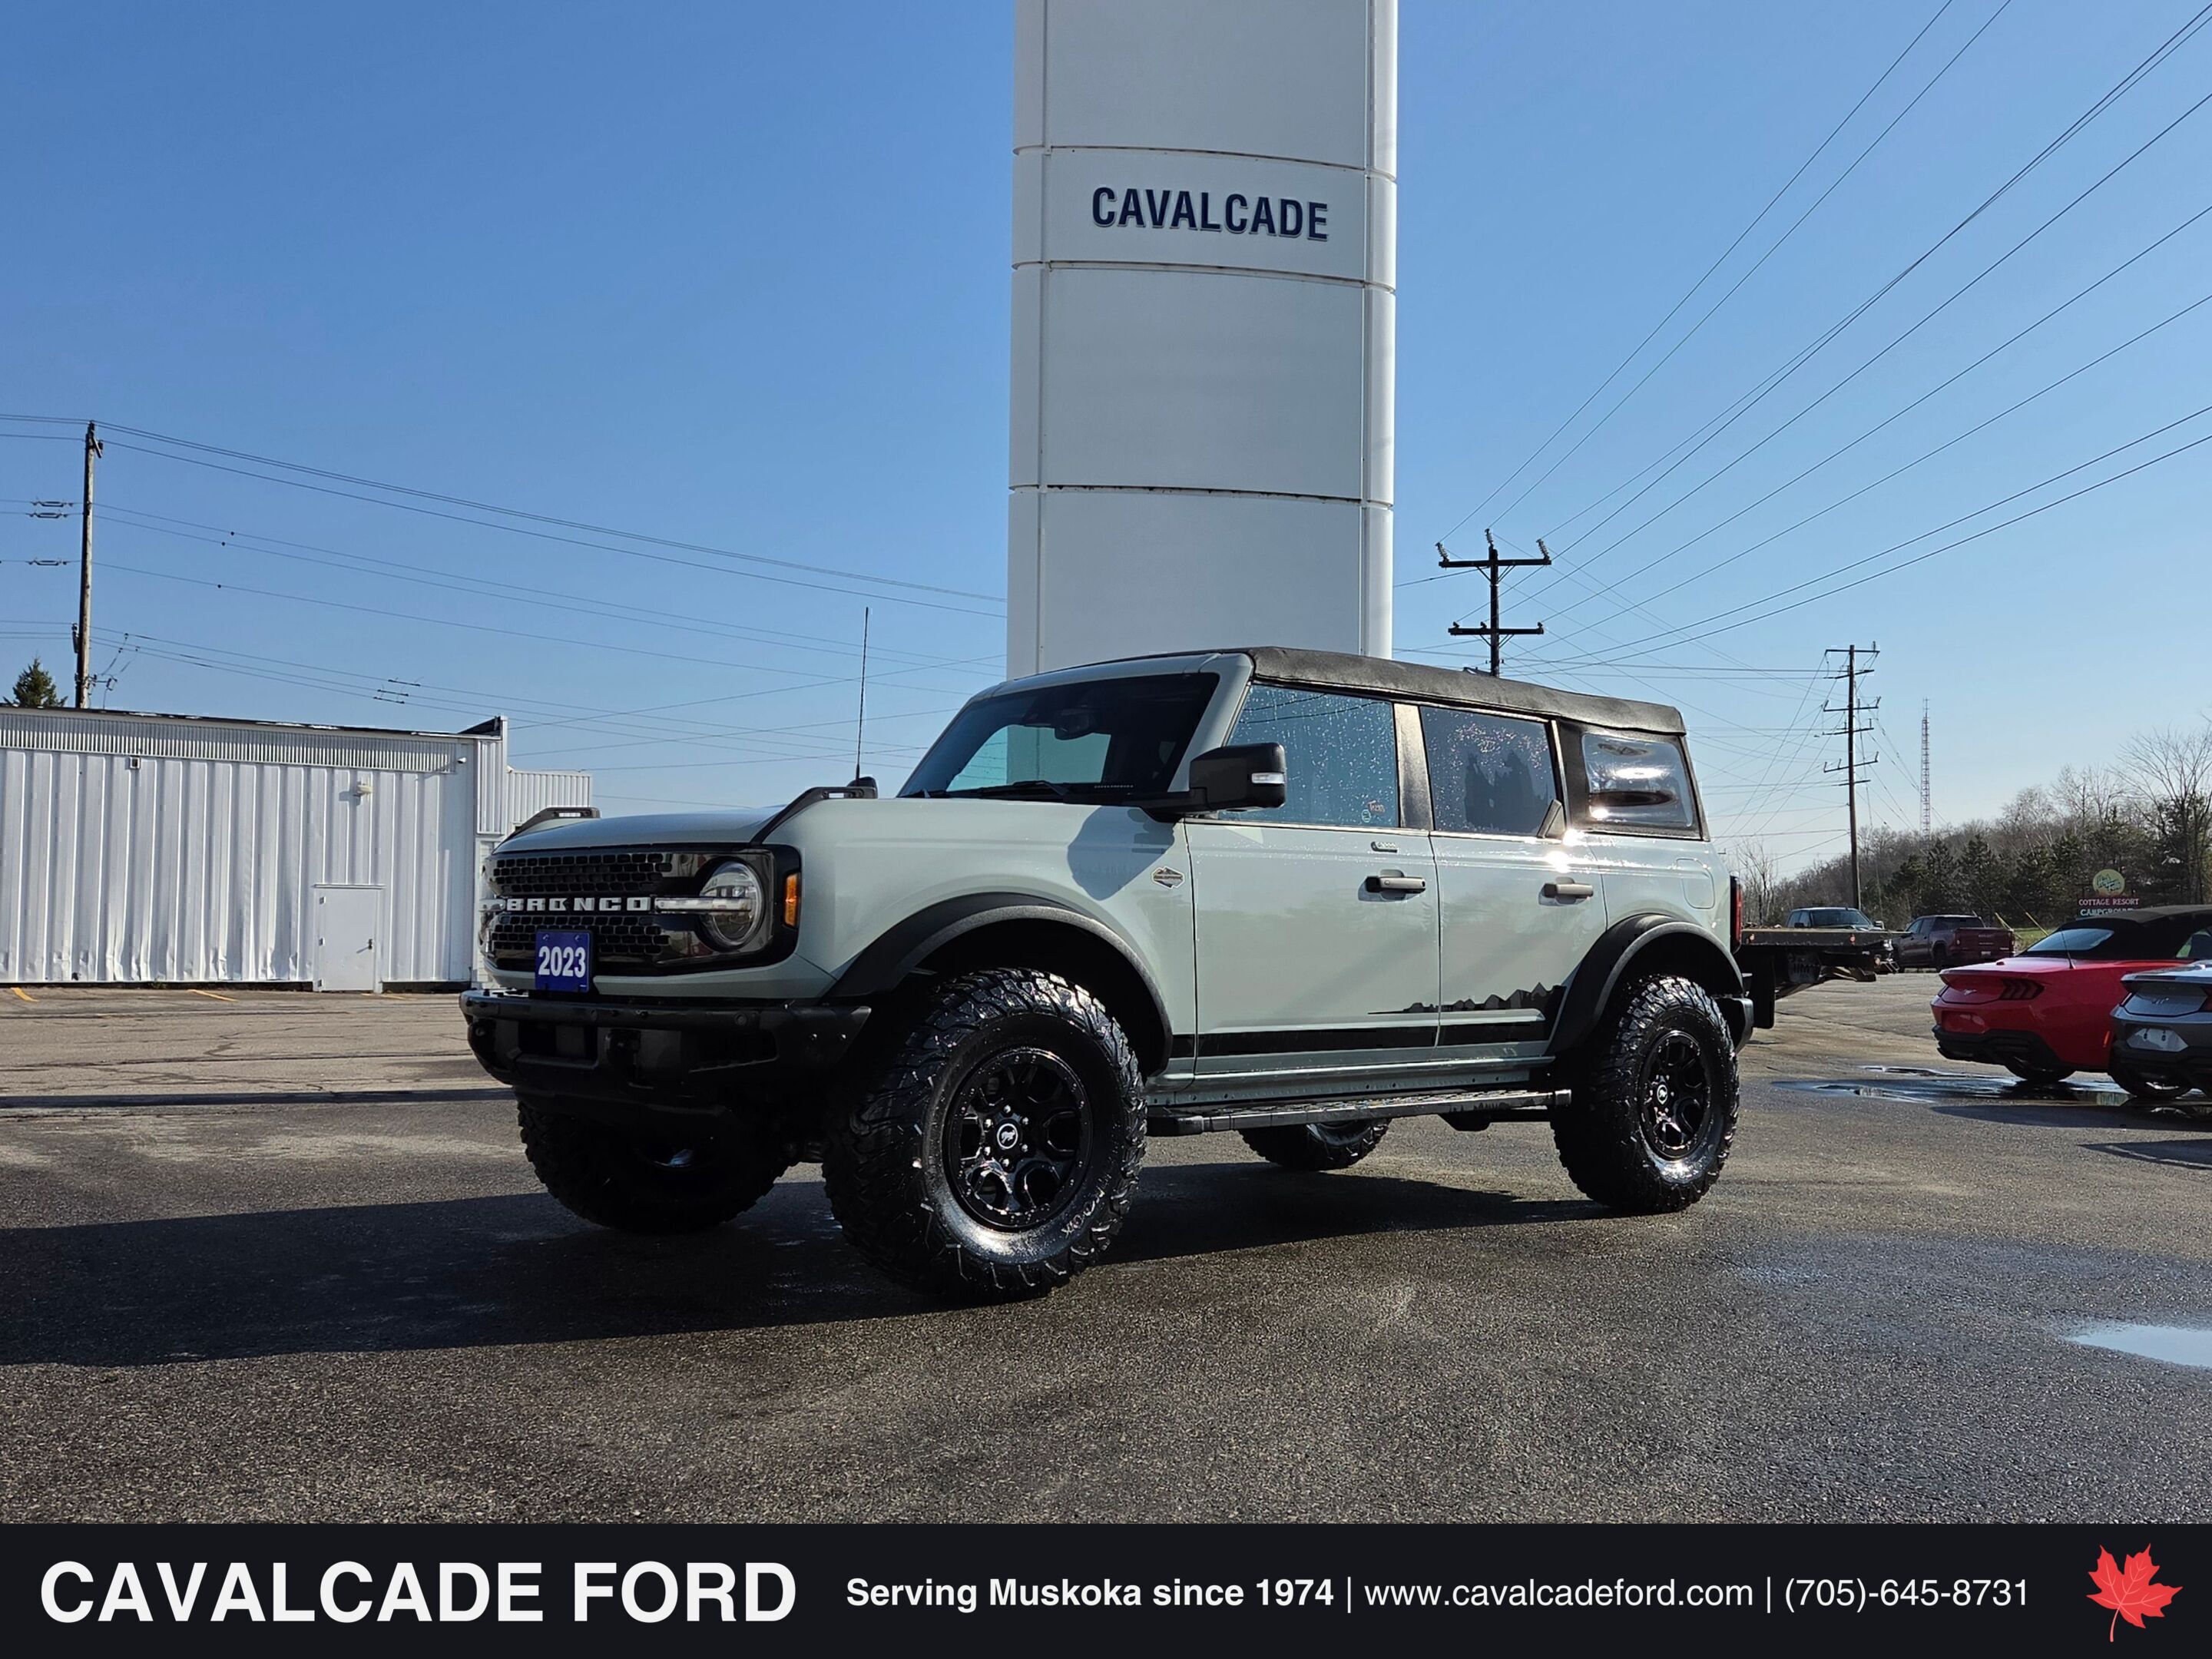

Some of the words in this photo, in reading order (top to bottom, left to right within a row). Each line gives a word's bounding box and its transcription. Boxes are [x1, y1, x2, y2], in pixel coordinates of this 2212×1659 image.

[1092, 187, 1329, 241] CAVALCADE
[507, 897, 651, 911] BRONCO
[538, 946, 586, 978] 2023
